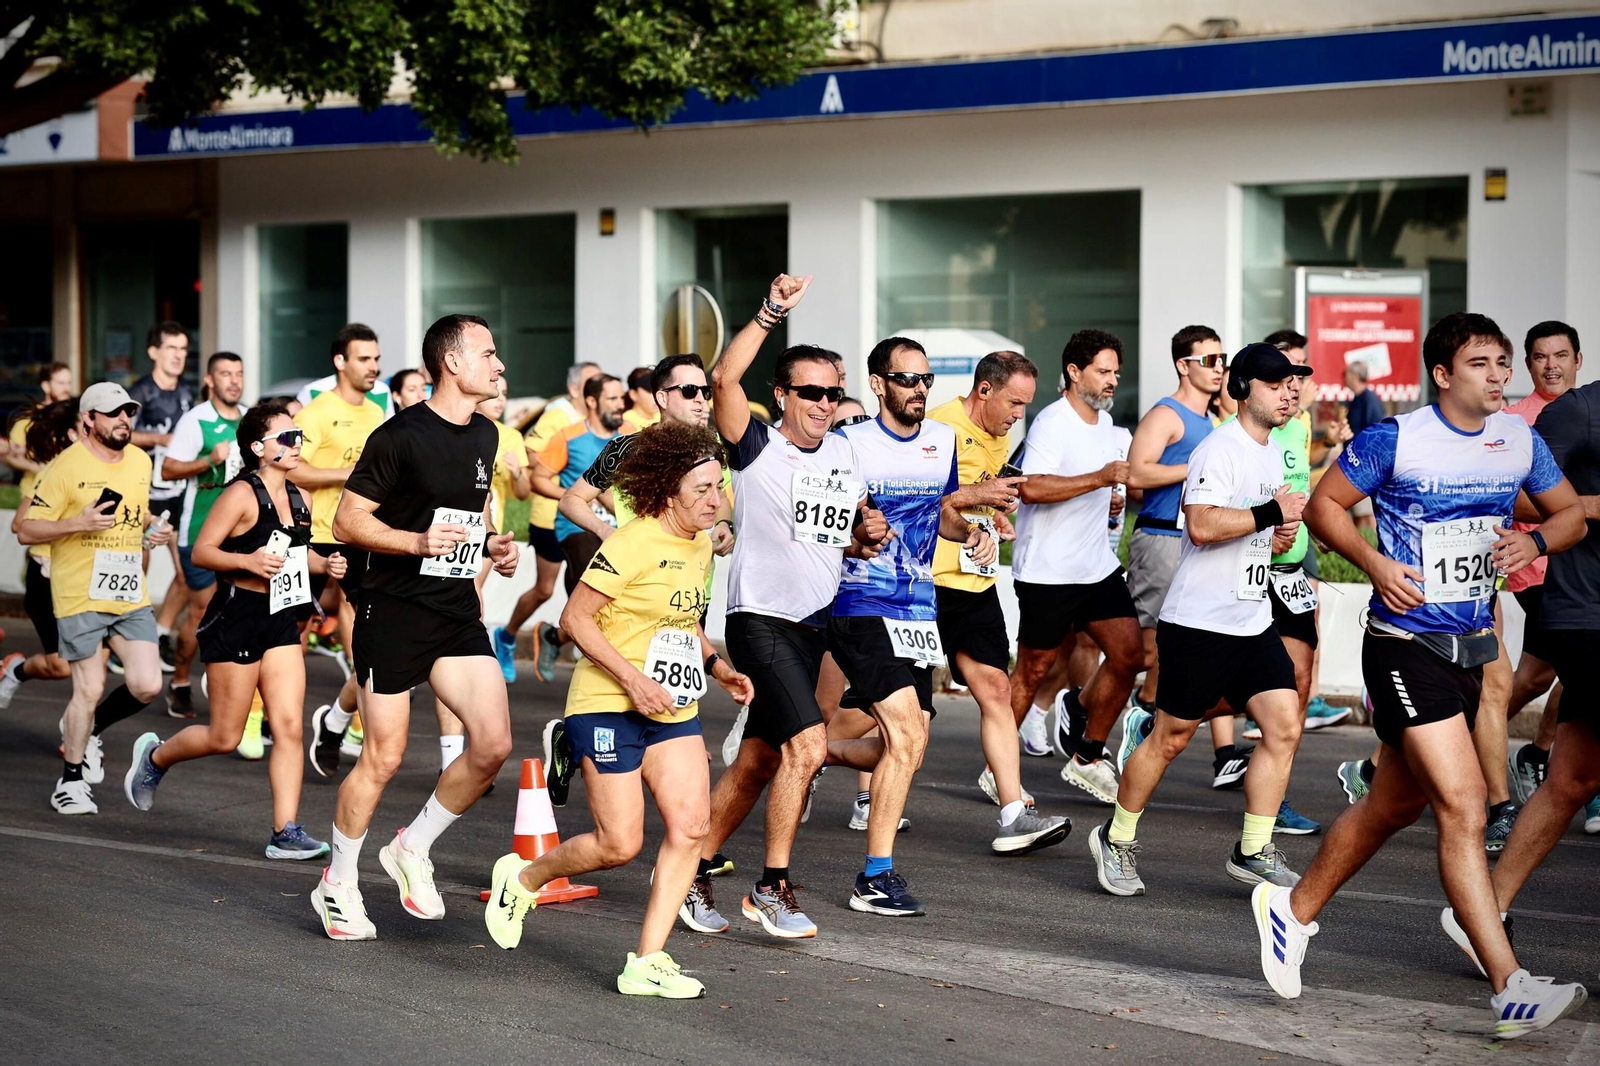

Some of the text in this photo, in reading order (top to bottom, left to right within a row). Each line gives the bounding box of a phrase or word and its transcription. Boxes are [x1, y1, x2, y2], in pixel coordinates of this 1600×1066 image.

[184, 122, 294, 151] MonteAlminara
[868, 480, 885, 495] 31
[887, 479, 939, 489] TotalEnergies
[1416, 475, 1439, 493] 31
[1441, 474, 1515, 485] TotalEnergies
[1452, 486, 1485, 494] MARATÓN
[1486, 485, 1512, 493] MÁLAGA
[795, 500, 851, 531] 8185
[435, 541, 481, 565] 307
[1434, 551, 1494, 584] 1520
[97, 573, 138, 591] 7826
[272, 570, 302, 598] 7991
[1280, 579, 1313, 603] 6490
[669, 590, 692, 612] 45
[893, 627, 938, 651] 1306
[651, 660, 702, 691] 5890
